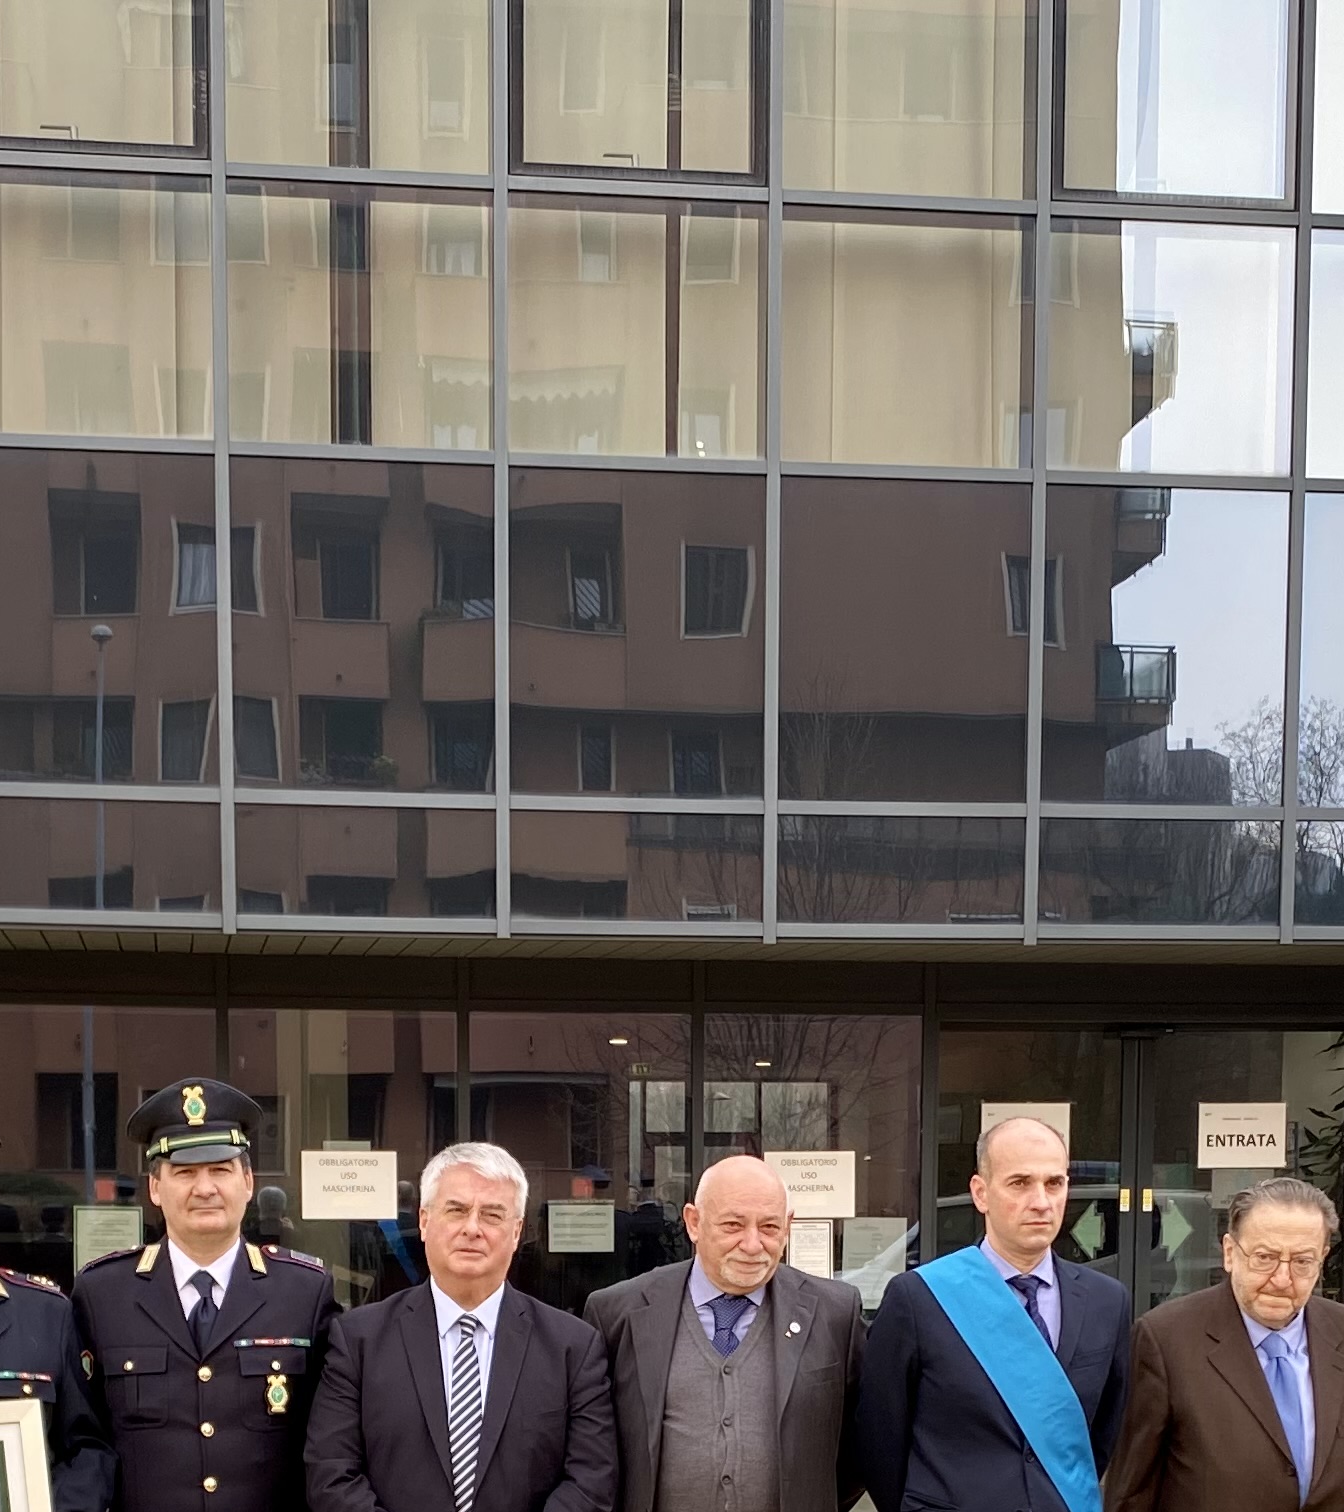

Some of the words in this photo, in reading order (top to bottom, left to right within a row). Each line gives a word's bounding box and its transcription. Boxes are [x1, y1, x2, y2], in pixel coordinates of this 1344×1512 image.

[1206, 1133, 1277, 1148] ENTRATA
[319, 1159, 378, 1167] OBBLIGATORIO
[781, 1159, 837, 1167] OBBLIGATORIO
